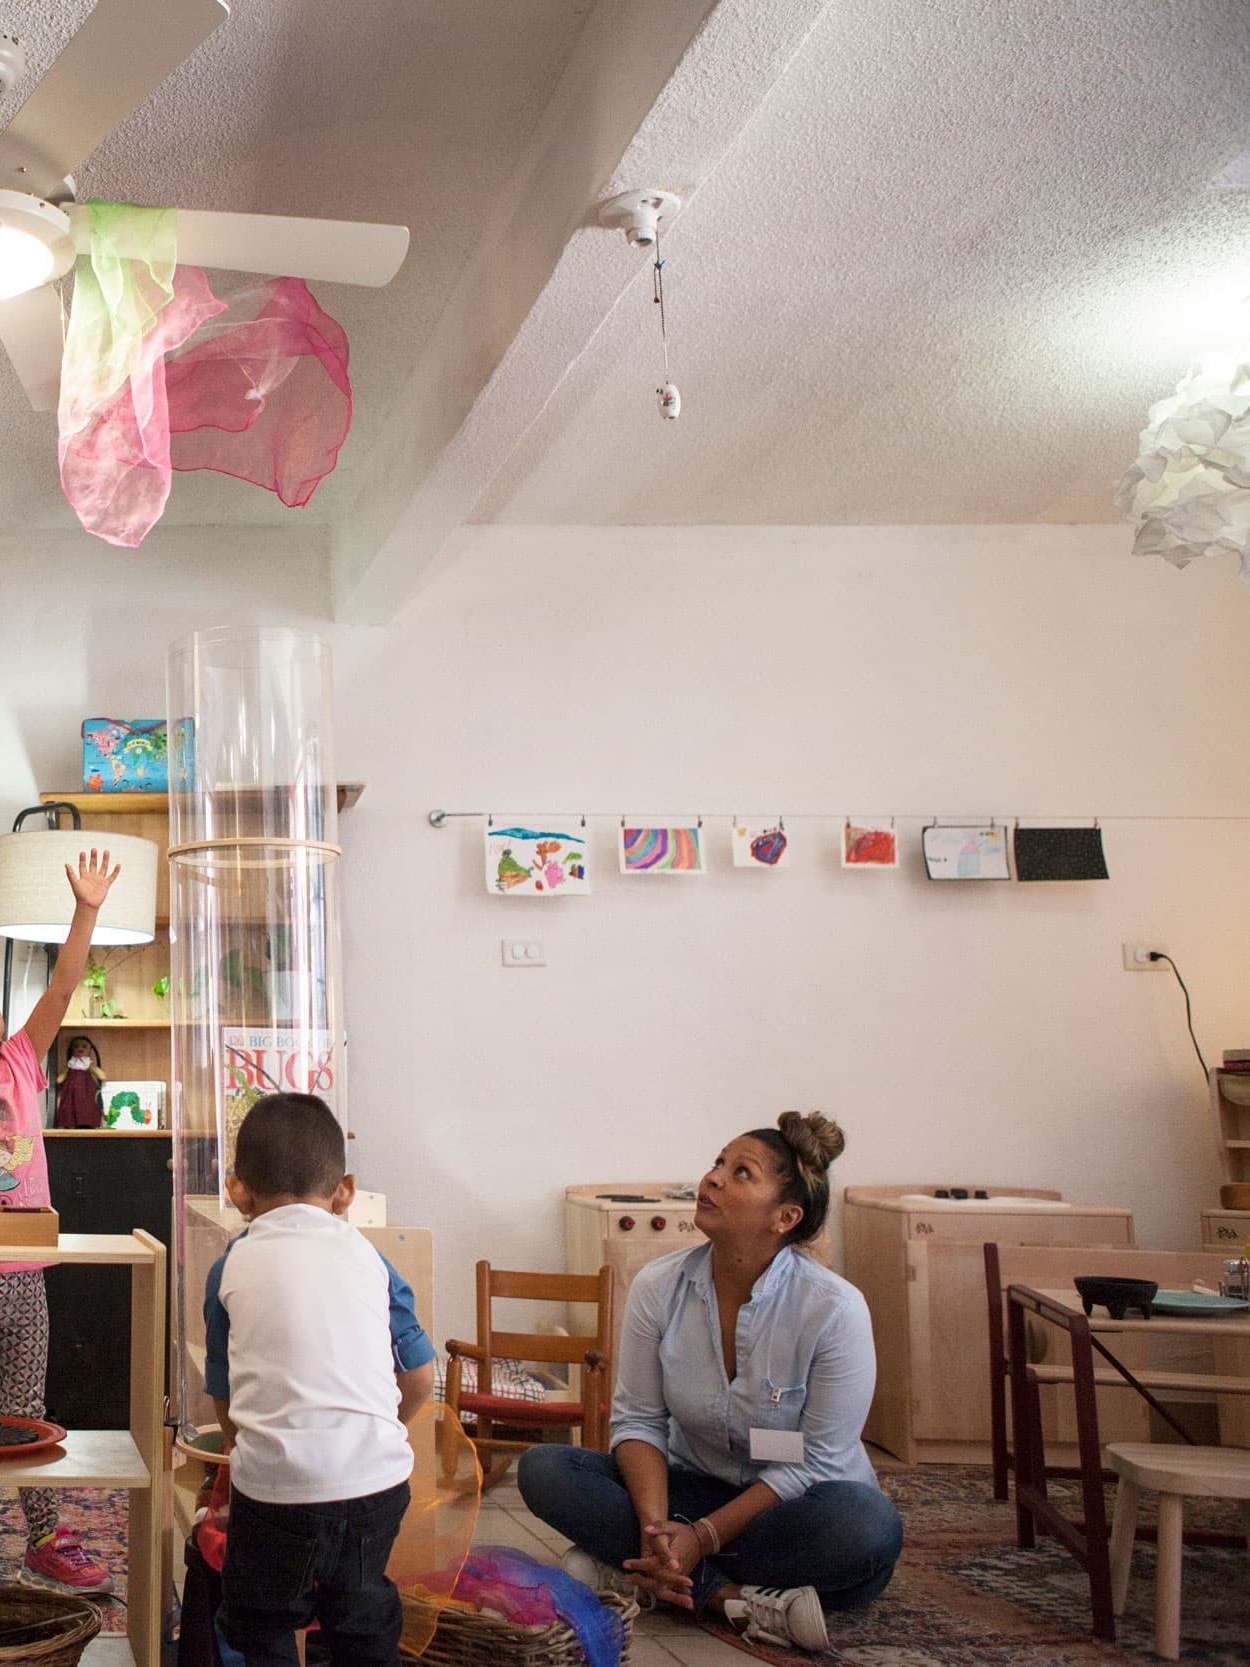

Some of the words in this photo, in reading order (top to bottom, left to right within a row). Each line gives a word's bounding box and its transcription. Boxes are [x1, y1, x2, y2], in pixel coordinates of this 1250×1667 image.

[249, 1035, 272, 1048] BIG
[277, 1035, 314, 1048] BO
[225, 1049, 333, 1091] BUGS
